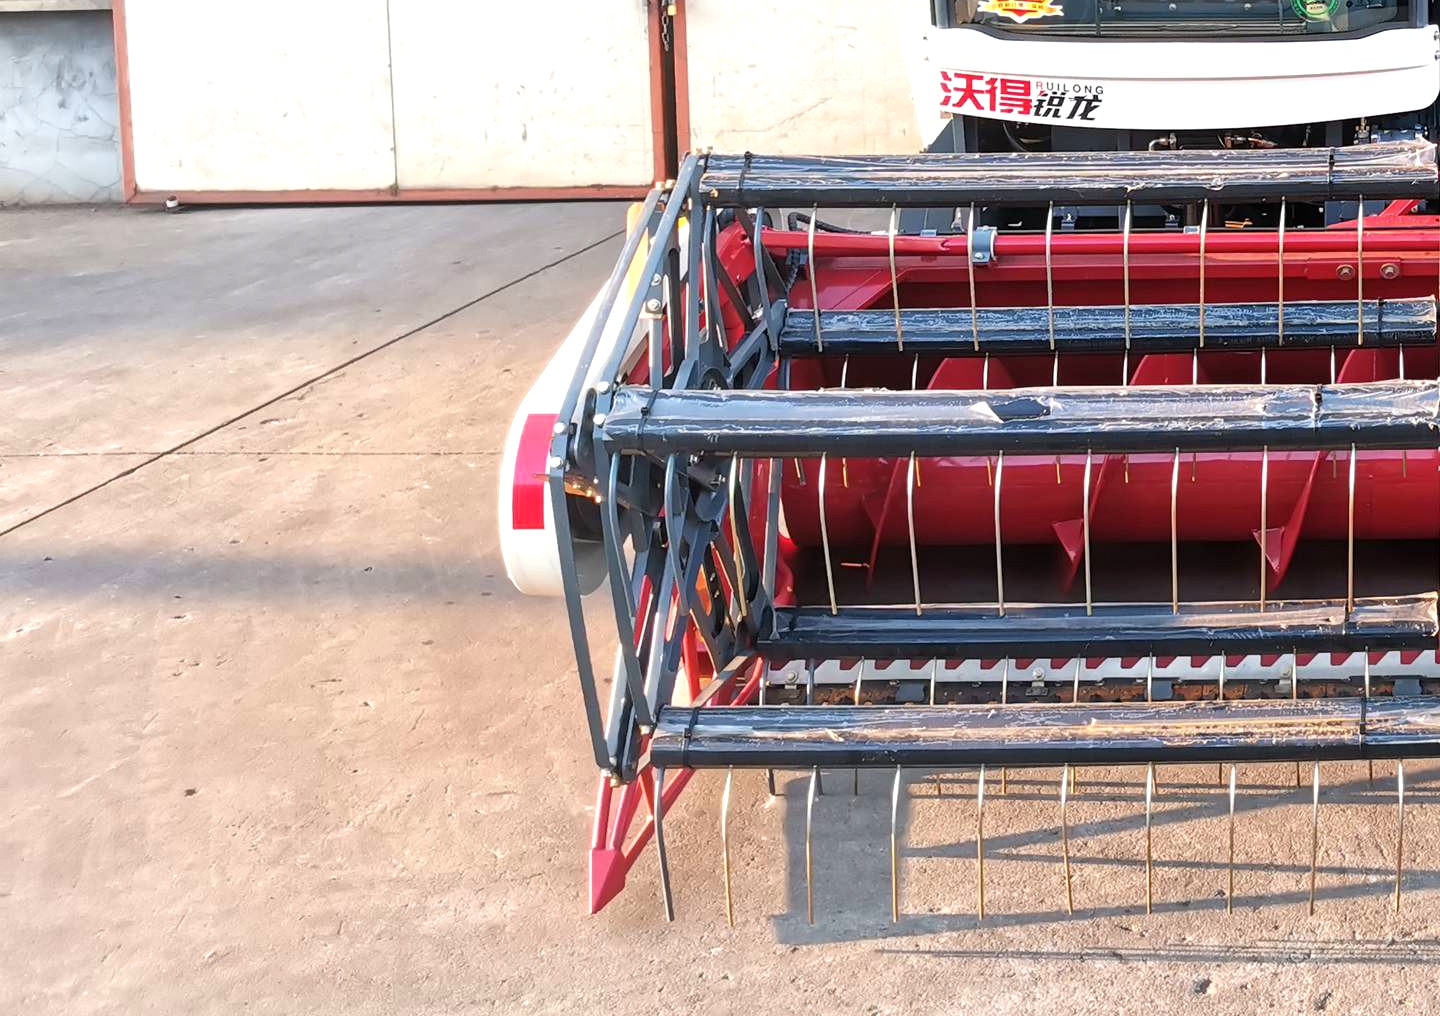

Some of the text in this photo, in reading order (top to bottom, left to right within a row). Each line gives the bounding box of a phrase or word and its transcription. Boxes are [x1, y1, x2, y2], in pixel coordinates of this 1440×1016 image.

[939, 70, 1034, 116] 沃得
[1035, 81, 1104, 95] RUILONG
[1033, 90, 1103, 121] 锐龙
